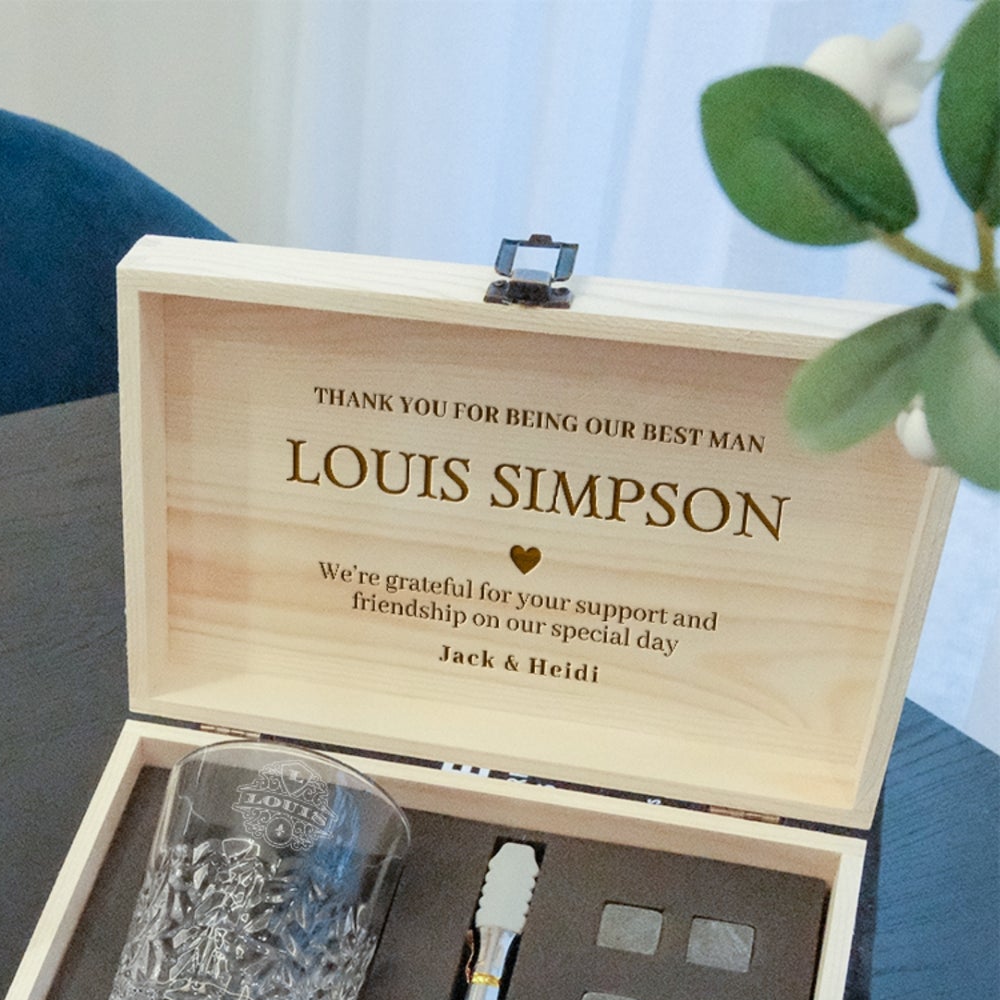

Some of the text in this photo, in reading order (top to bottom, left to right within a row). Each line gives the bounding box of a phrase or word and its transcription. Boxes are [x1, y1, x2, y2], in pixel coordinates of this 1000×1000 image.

[314, 387, 766, 454] THANK YOU FOR BEING OUR BEST MAN
[286, 438, 791, 542] LOUIS SIMPSON
[318, 560, 719, 632] We're grateful for your support and
[352, 591, 679, 657] friendship on our special day
[438, 644, 600, 683] Jack & Heidi
[246, 793, 326, 826] LOUIS
